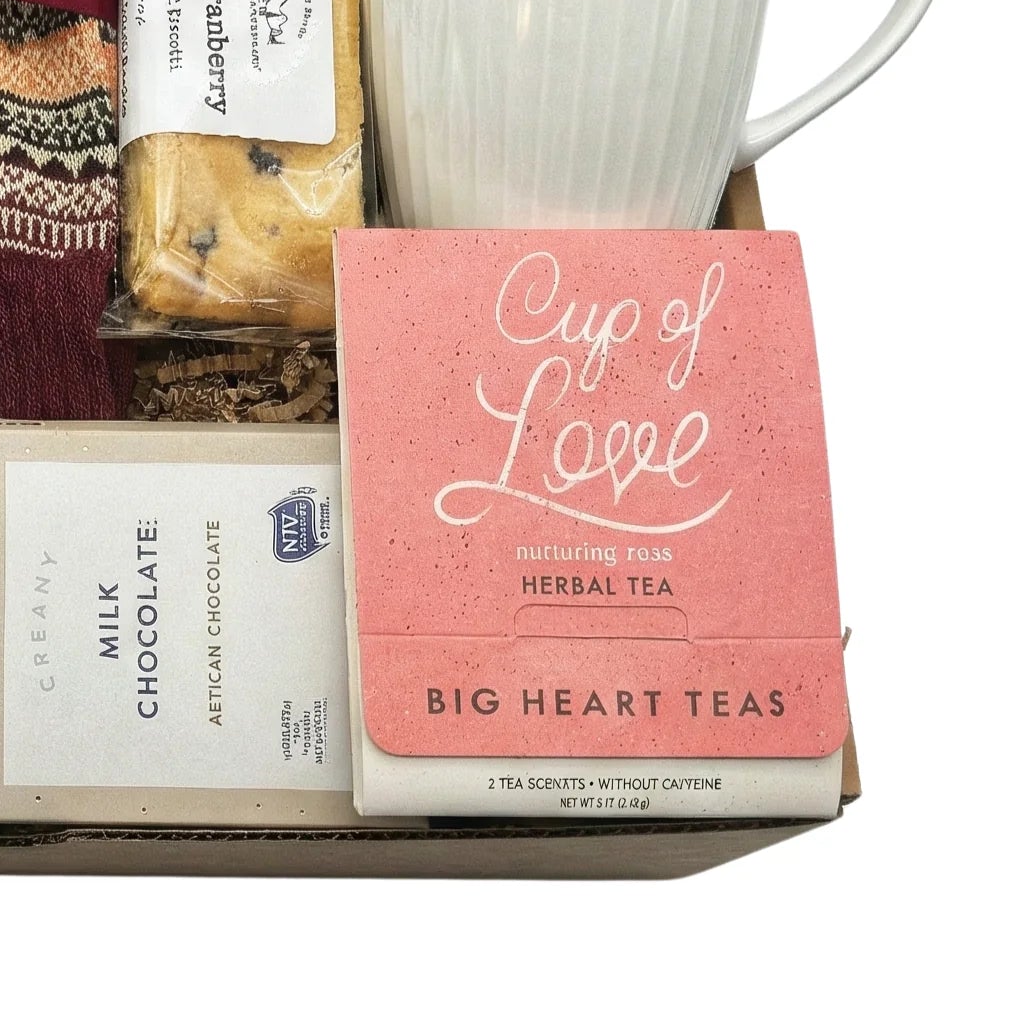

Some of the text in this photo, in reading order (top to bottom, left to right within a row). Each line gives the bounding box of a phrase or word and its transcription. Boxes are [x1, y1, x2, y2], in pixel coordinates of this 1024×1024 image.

[495, 251, 725, 392] Cup of
[434, 355, 733, 535] Love
[516, 542, 617, 566] nurturing
[522, 576, 674, 596] HERBAL TEA
[29, 550, 58, 693] CREANY
[98, 582, 120, 660] MILK
[206, 519, 223, 727] AETICAN CHOCOLATE
[426, 687, 786, 718] BIG HEART TEAS
[488, 778, 495, 789] 2
[499, 778, 523, 789] TEA
[598, 778, 659, 790] WITHOUT
[560, 797, 577, 808] NET
[580, 797, 594, 808] WT
